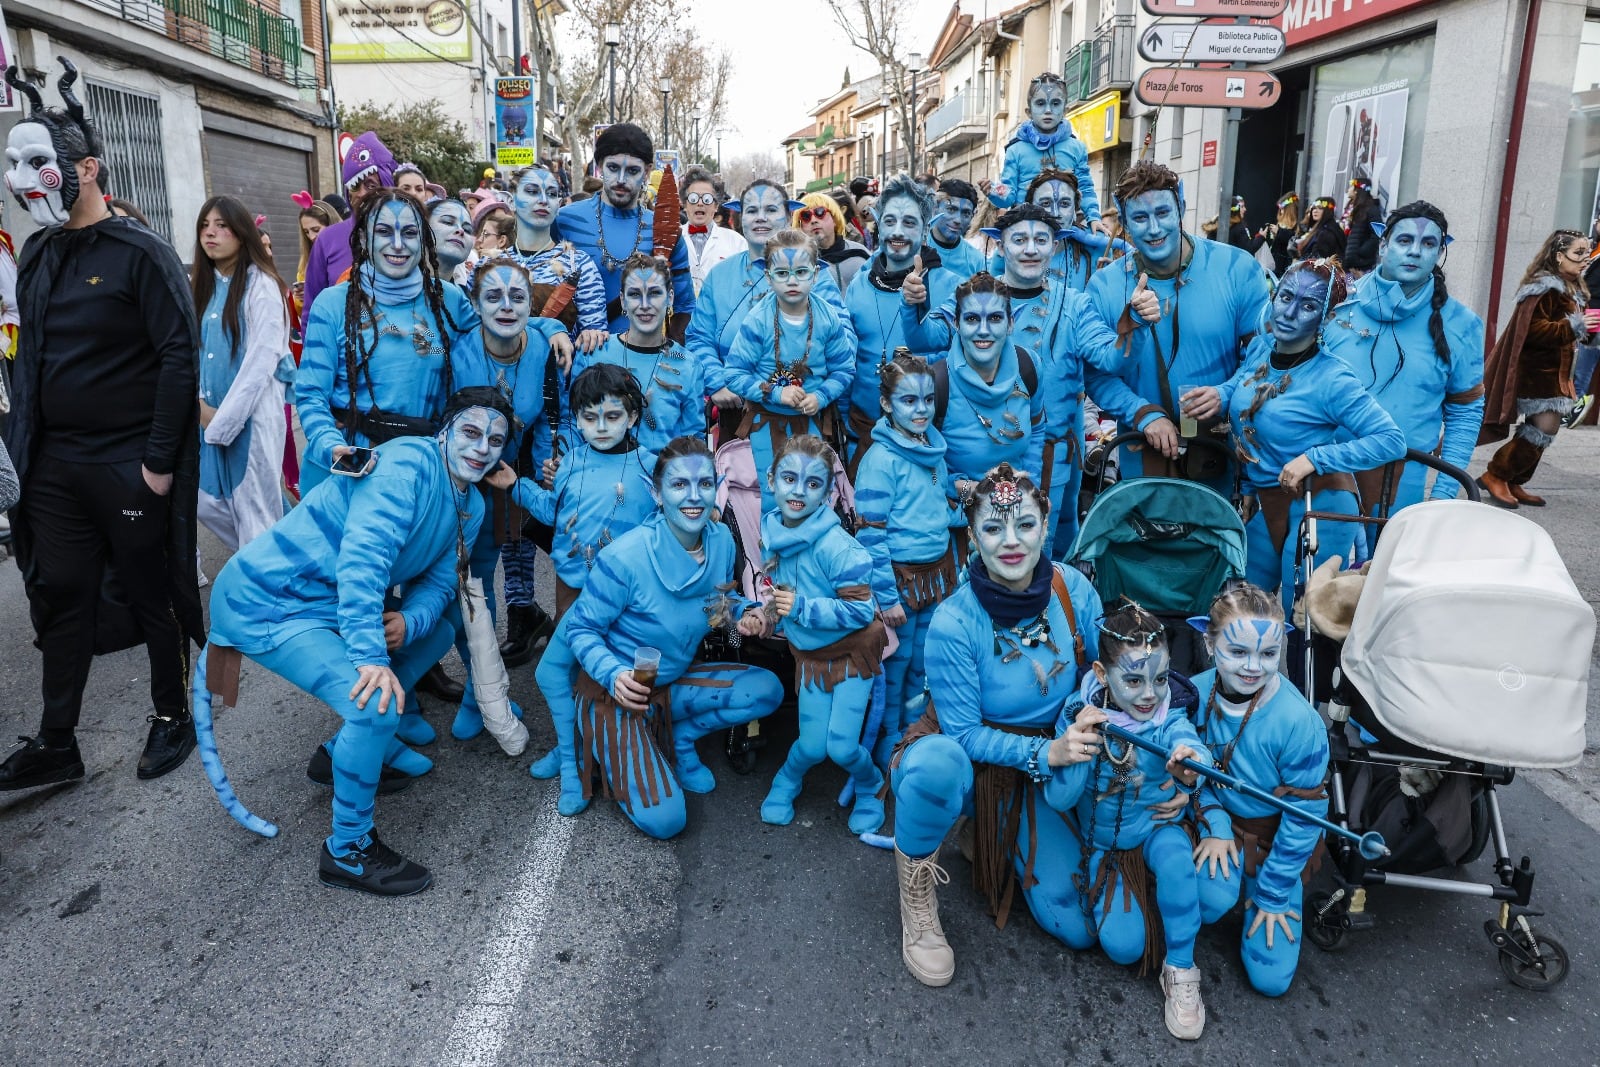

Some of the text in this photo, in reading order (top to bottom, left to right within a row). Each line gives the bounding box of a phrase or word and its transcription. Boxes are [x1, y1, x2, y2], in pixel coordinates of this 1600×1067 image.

[1240, 0, 1280, 8] Colmenarejo
[1218, 31, 1252, 40] Biblioteca
[1208, 44, 1277, 54] Miguel de Cervantes
[497, 79, 531, 91] COLISEO
[1145, 81, 1167, 91] Plaza
[1180, 82, 1204, 92] Toros
